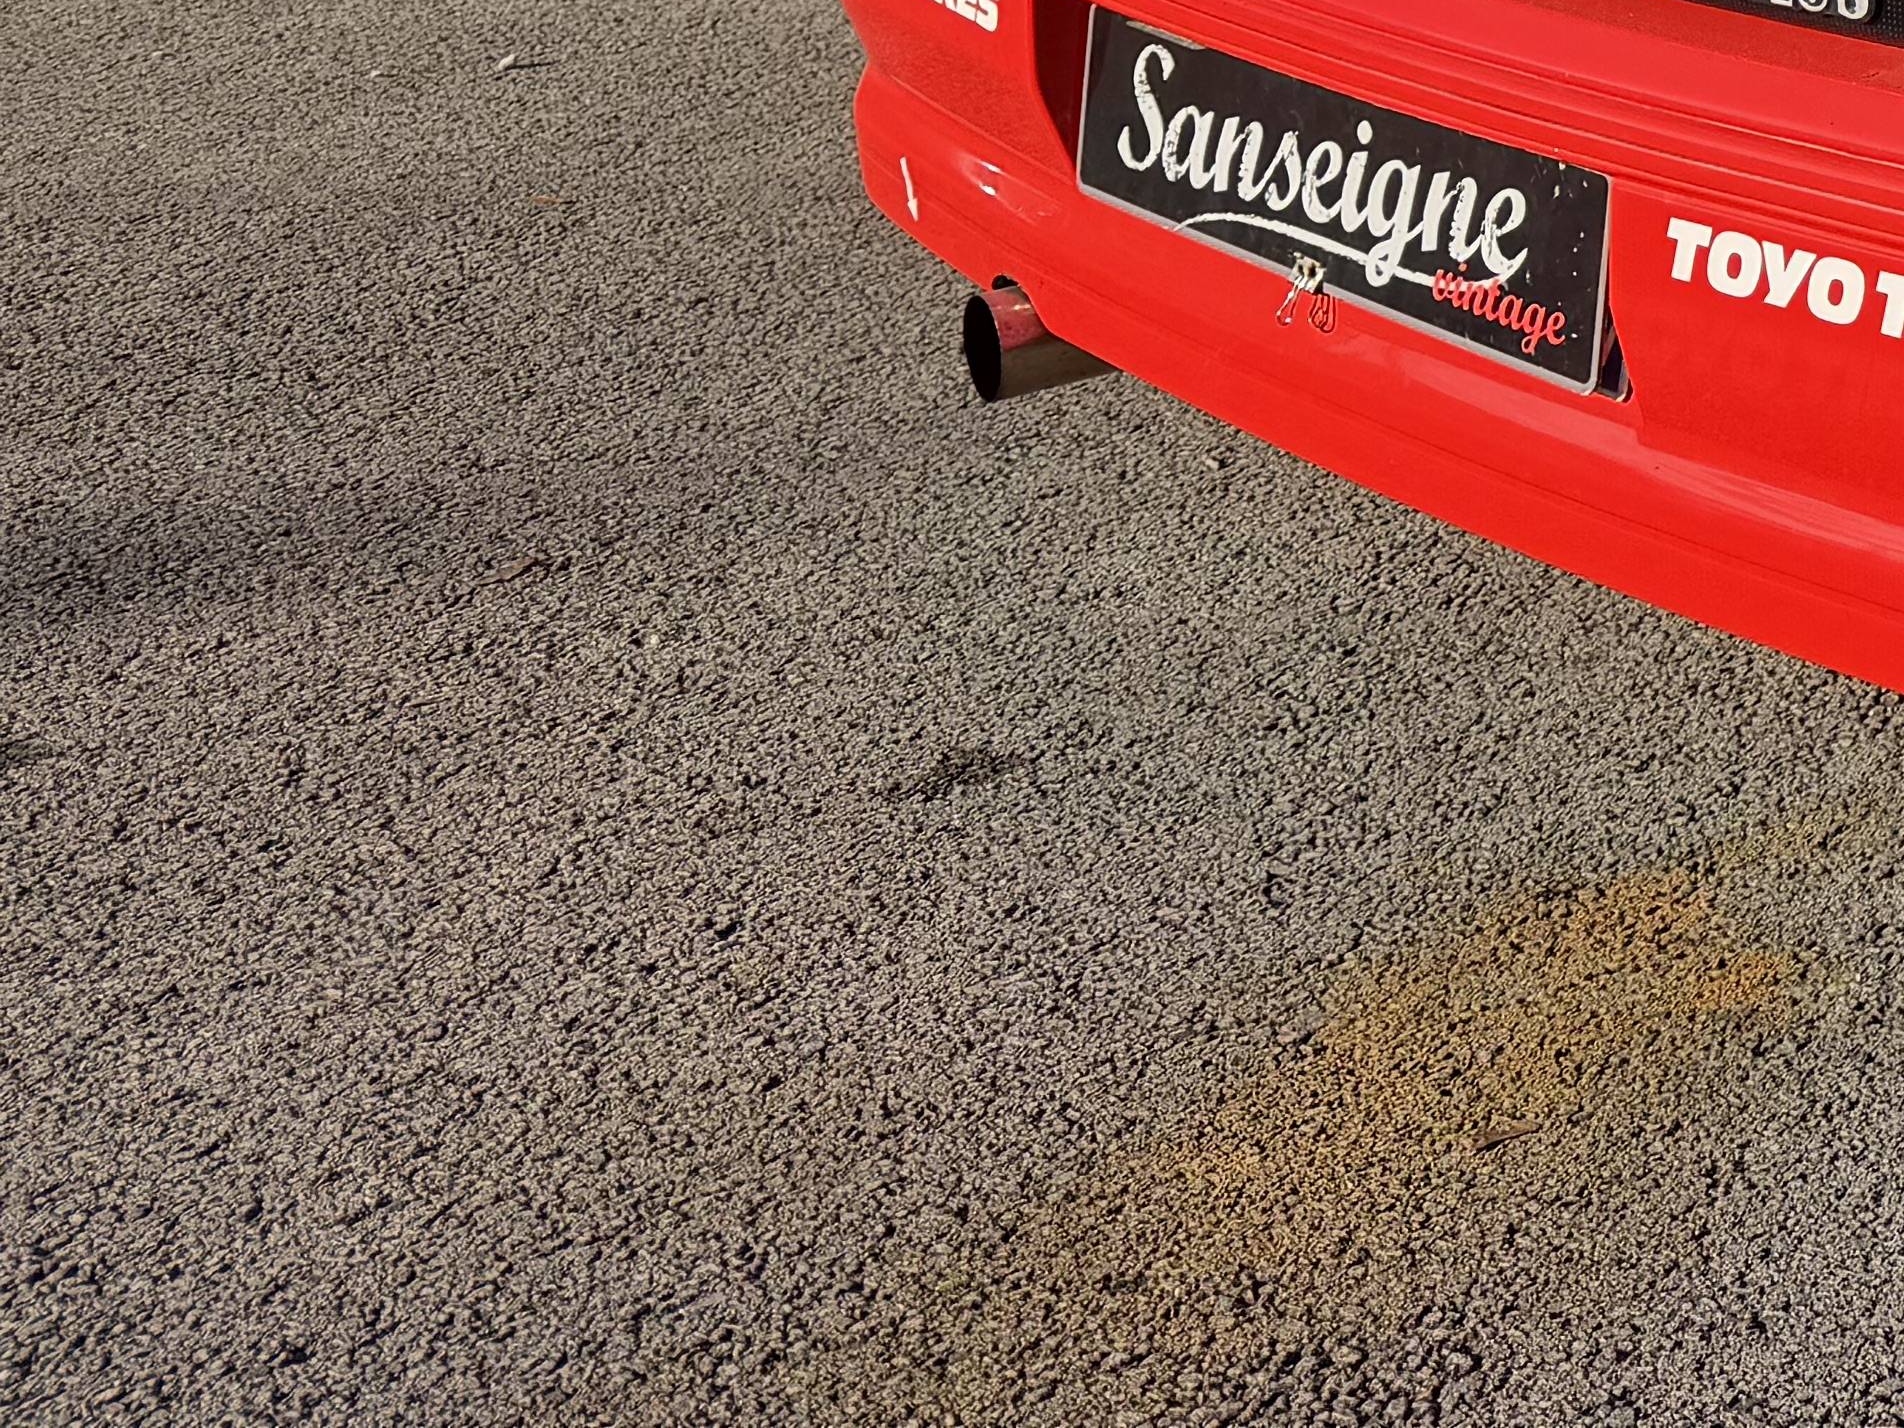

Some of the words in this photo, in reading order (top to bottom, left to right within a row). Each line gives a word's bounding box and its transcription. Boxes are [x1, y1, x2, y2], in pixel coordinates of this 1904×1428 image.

[1117, 43, 1530, 287] Sanseigne
[1432, 263, 1567, 355] vintage
[1666, 216, 1866, 326] TOYO
